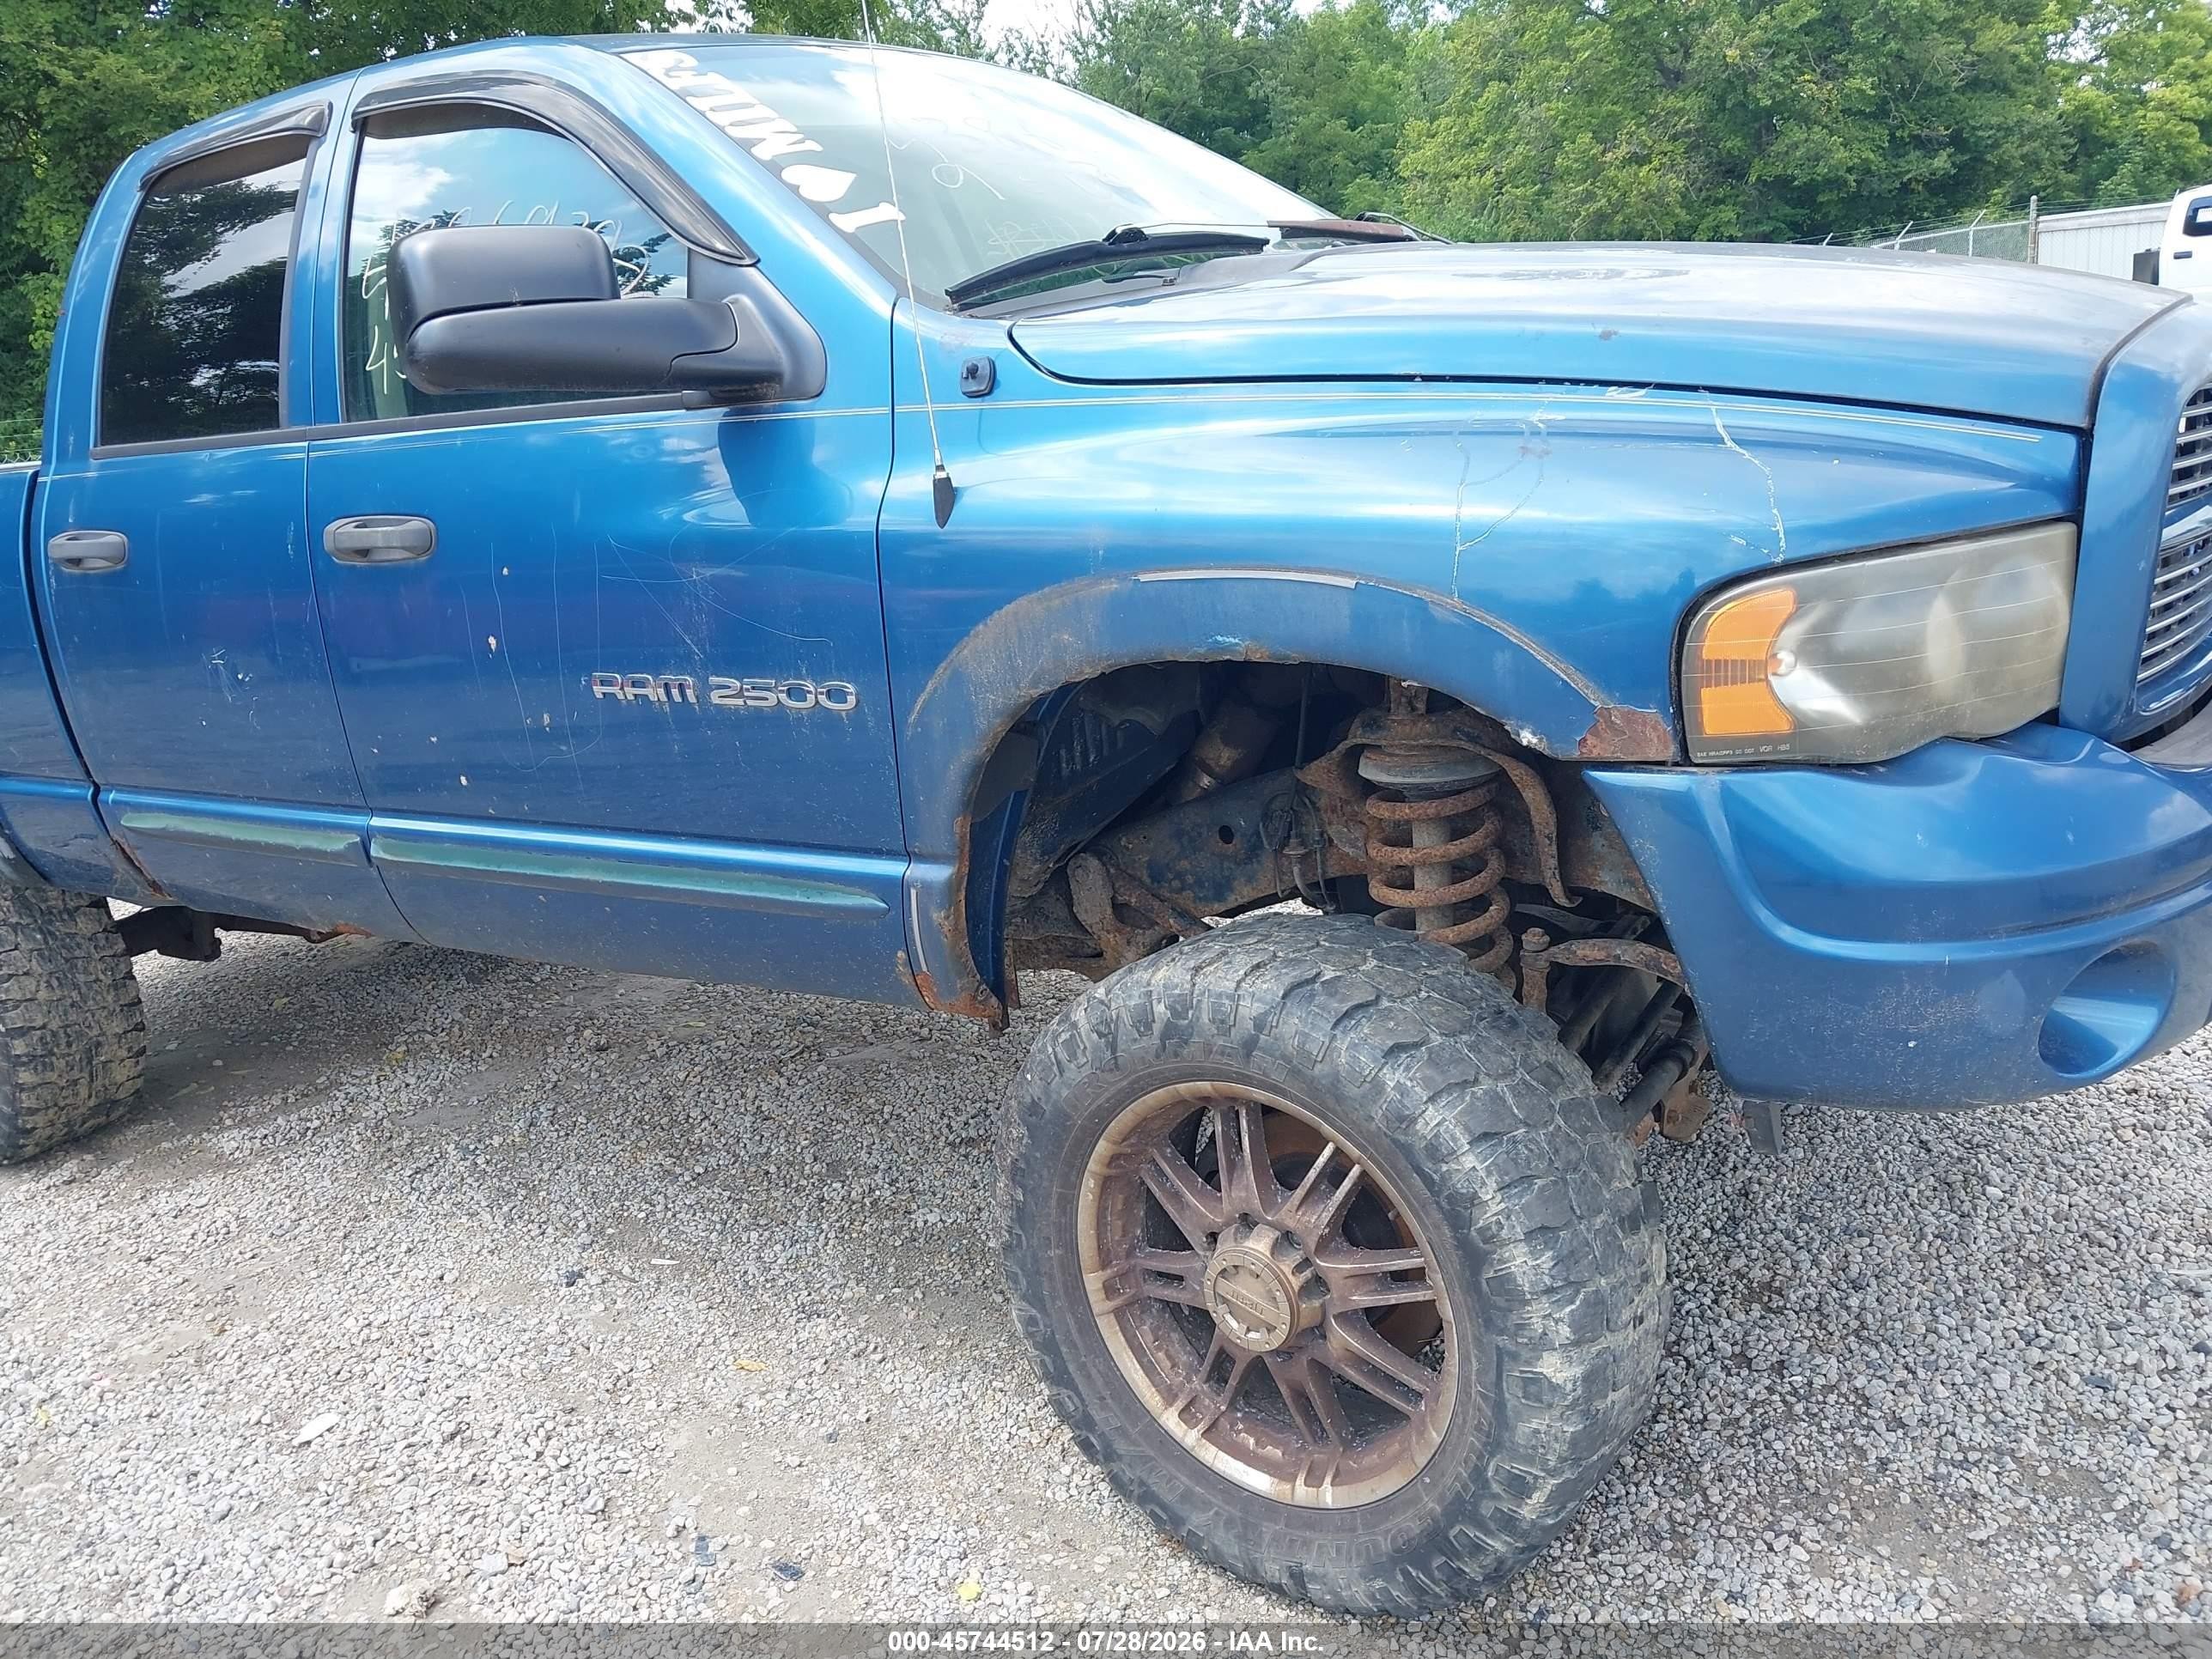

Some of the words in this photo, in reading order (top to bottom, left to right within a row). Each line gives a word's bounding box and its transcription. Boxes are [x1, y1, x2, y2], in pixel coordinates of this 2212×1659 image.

[828, 202, 906, 233] I
[591, 672, 698, 703] RAM
[708, 677, 859, 711] 2500
